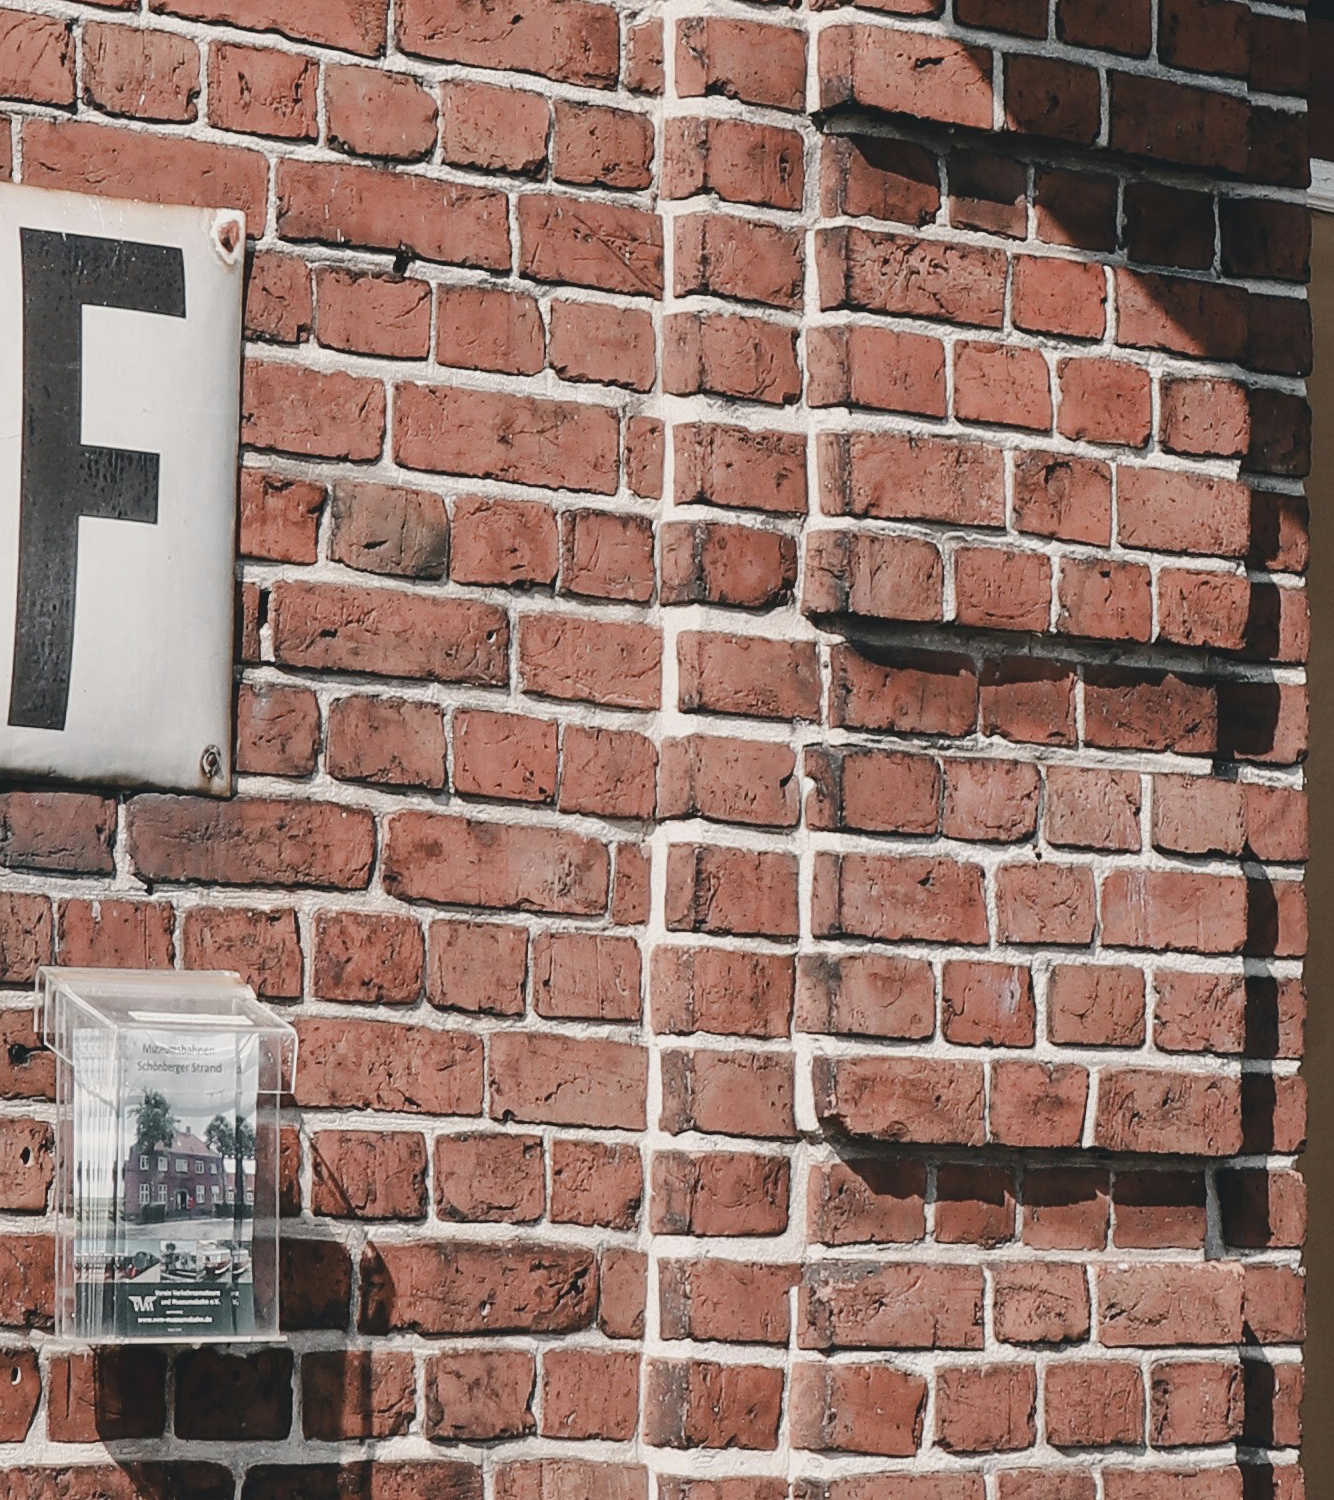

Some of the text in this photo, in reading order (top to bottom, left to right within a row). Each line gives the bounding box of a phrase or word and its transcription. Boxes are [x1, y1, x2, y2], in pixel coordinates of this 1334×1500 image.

[8, 226, 186, 731] F
[137, 1061, 222, 1074] Schönberger Strand
